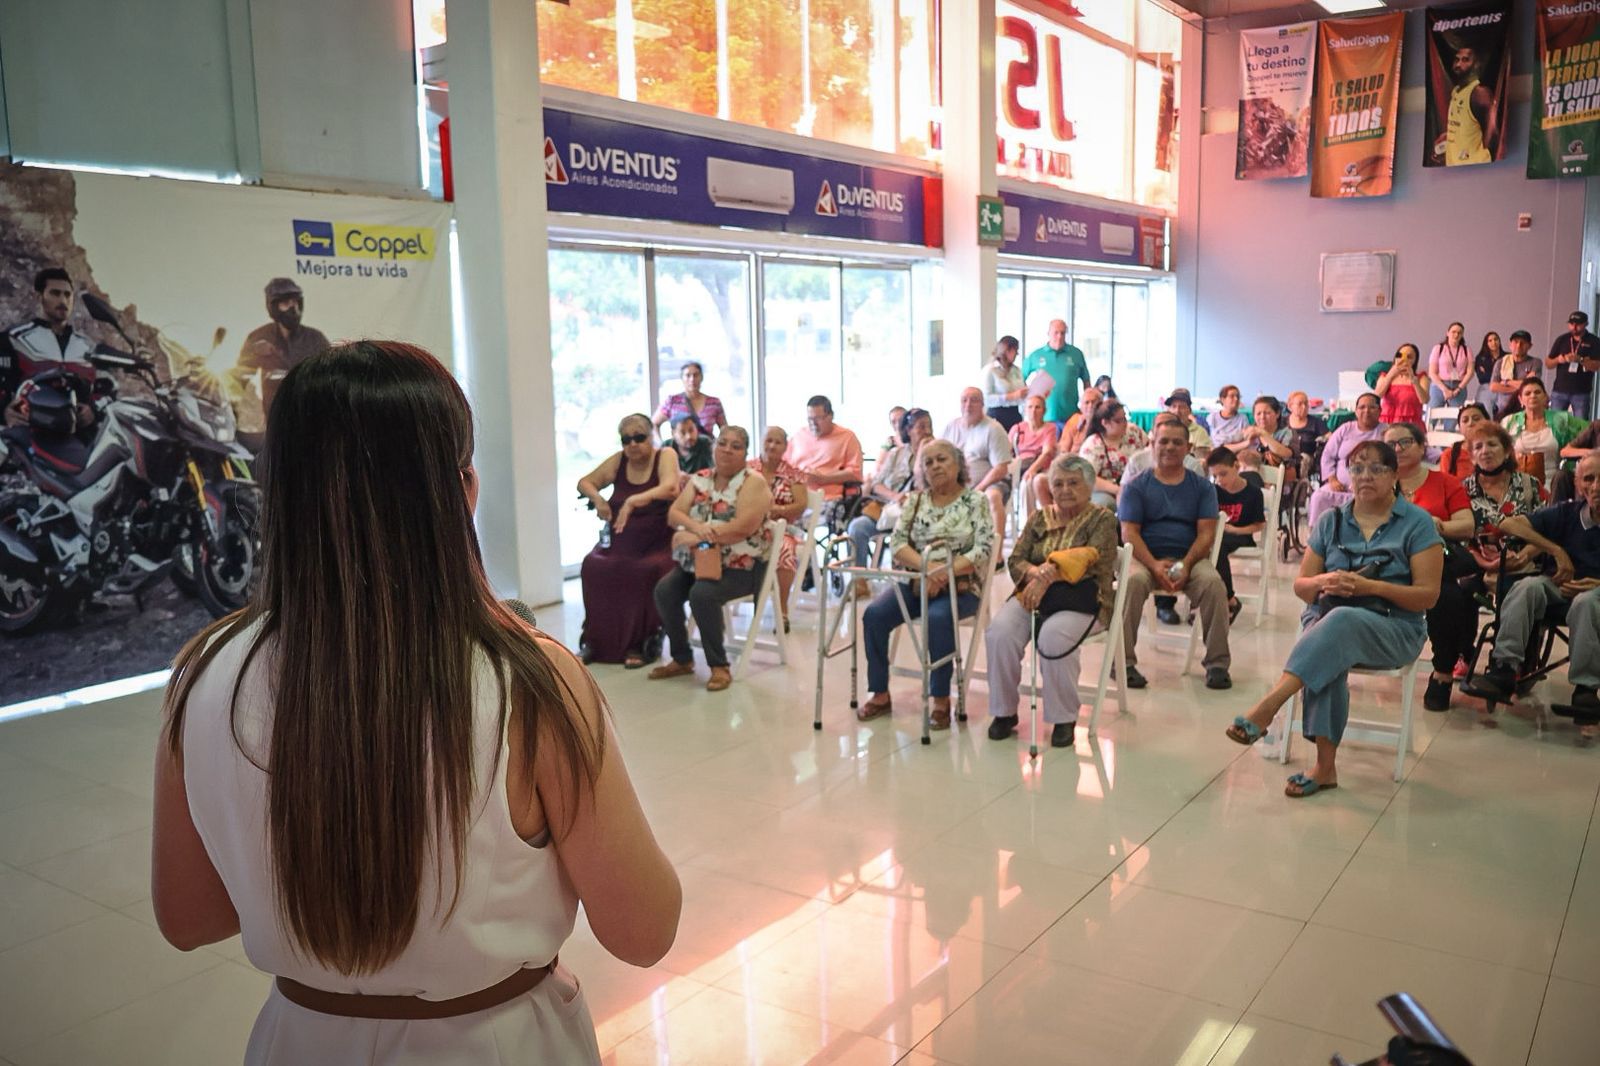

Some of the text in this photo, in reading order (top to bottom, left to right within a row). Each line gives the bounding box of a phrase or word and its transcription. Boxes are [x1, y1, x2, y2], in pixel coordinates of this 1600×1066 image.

[1247, 45, 1290, 58] Llega a
[1545, 49, 1561, 68] LA
[1247, 56, 1306, 72] tu destino
[1346, 74, 1385, 95] SALUD
[1546, 85, 1560, 104] ES
[1346, 92, 1379, 113] PARA
[1547, 102, 1563, 118] TU
[1328, 107, 1382, 137] TODOS
[569, 143, 678, 181] DuVENTUS
[572, 171, 678, 195] Aires Acondicionados
[837, 184, 903, 212] DuVENTUS
[346, 230, 427, 259] Coppel
[296, 260, 408, 279] Mejora tu vida
